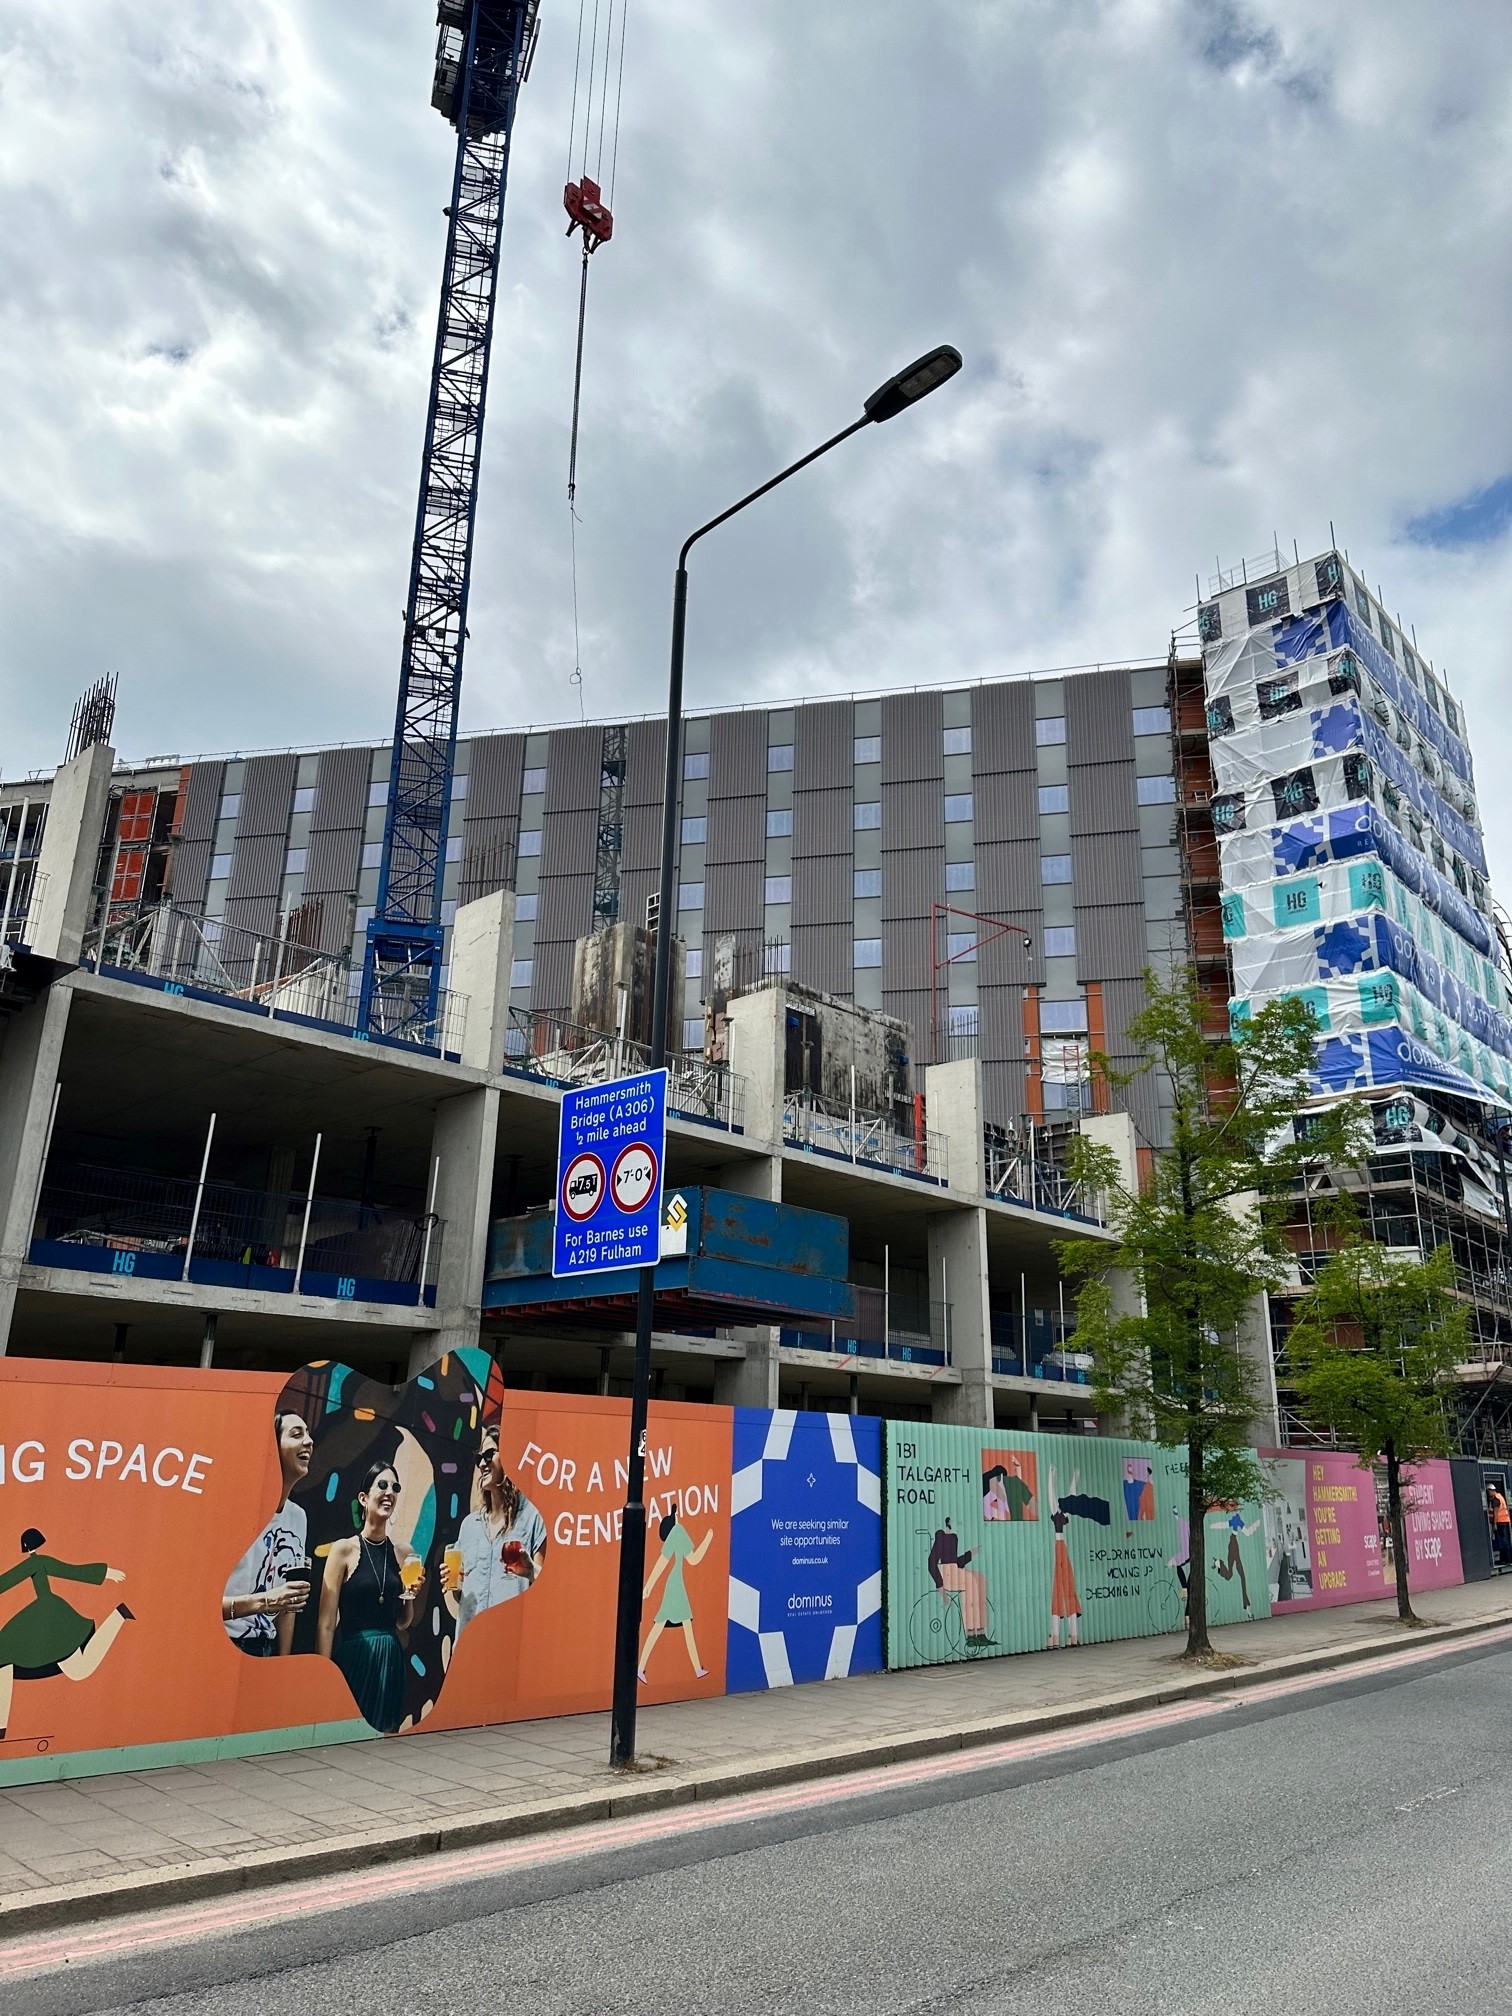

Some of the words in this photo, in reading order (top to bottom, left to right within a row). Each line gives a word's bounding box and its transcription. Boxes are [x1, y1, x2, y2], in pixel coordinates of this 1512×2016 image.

[1258, 590, 1277, 610] HG
[1283, 782, 1304, 802] HG
[1216, 804, 1235, 822] HG
[1286, 891, 1307, 910] HG
[576, 1081, 651, 1110] Hammersmith
[571, 1112, 605, 1129] Bridge
[610, 1098, 654, 1122] (A306)
[1386, 1106, 1410, 1127] HG
[586, 1126, 610, 1143] mile
[613, 1118, 647, 1137] ahead
[566, 1233, 582, 1248] For
[586, 1229, 624, 1244] Barnes
[629, 1225, 648, 1237] use
[113, 1250, 135, 1273] HG
[569, 1248, 597, 1266] A219
[602, 1244, 642, 1260] Fulham
[337, 1278, 355, 1296] HG
[848, 1339, 857, 1354] HG
[902, 1346, 912, 1361] HG
[65, 1438, 213, 1494] SPACE
[518, 1441, 577, 1492] FOR
[586, 1462, 604, 1493] A
[897, 1466, 970, 1483] TALGARTH
[1312, 1465, 1324, 1481] HEY
[898, 1489, 935, 1504] ROAD
[1408, 1484, 1434, 1504] STUDENT
[553, 1484, 720, 1547] GENEATION
[772, 1519, 784, 1530] We
[785, 1522, 798, 1530] are
[798, 1520, 826, 1532] seeking
[827, 1518, 848, 1530] similar
[1313, 1507, 1336, 1524] YOU'RE
[1412, 1511, 1431, 1532] LIVING
[1431, 1510, 1453, 1530] SHAPED
[780, 1535, 793, 1546] site
[794, 1535, 840, 1548] opportunities
[1315, 1528, 1341, 1546] GETTING
[1364, 1534, 1378, 1554] scape
[792, 1556, 828, 1565] dominus.co.uk
[1138, 1548, 1163, 1559] TOWN
[1318, 1550, 1328, 1568] AN
[1414, 1539, 1424, 1560] BY
[1424, 1537, 1442, 1567] scape
[1318, 1570, 1347, 1590] UPGRADE
[1132, 1585, 1140, 1596] IN
[788, 1594, 832, 1609] dominus
